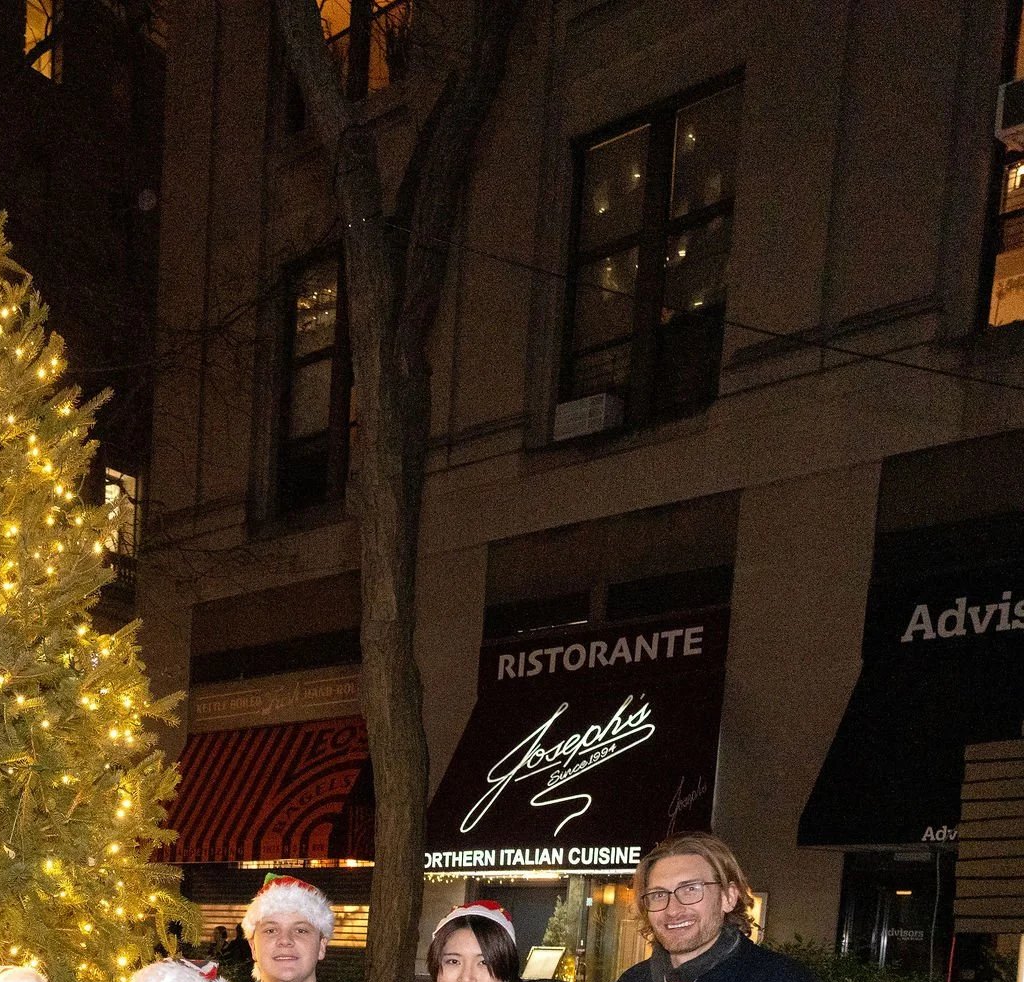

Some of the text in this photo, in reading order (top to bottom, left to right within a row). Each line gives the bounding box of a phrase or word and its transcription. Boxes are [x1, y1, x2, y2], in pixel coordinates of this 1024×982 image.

[497, 626, 704, 681] RISTORANTE
[460, 692, 653, 834] Joseph's
[547, 743, 617, 787] Since 1994
[921, 825, 958, 842] Adv
[424, 846, 642, 869] ORTHERN ITALIAN CUISINE
[886, 927, 924, 937] dvisors
